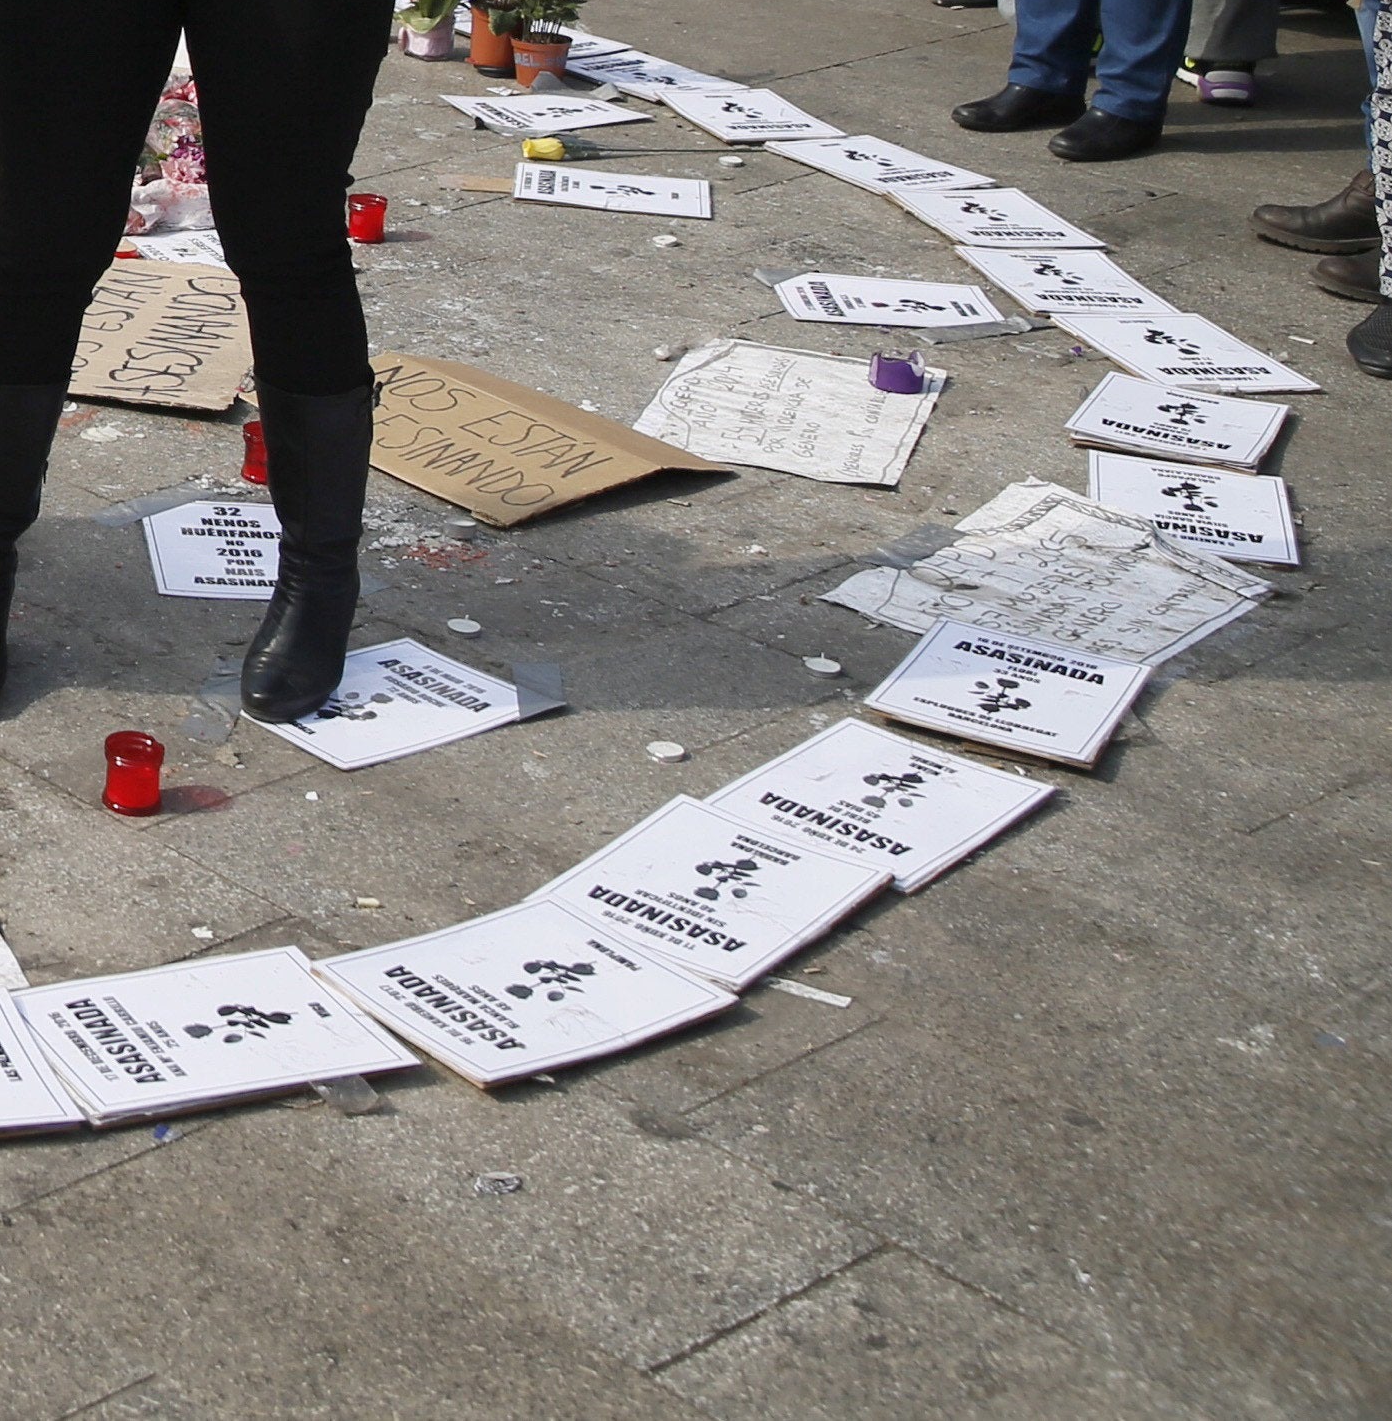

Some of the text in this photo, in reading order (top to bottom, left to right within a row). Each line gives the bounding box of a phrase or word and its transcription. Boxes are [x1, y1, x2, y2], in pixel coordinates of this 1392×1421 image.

[95, 275, 242, 397] ASESINANDO
[374, 365, 613, 479] NOS ESTÁN
[180, 525, 283, 540] HUÉRFANOS
[200, 517, 261, 529] NENOS
[212, 506, 242, 517] 32
[215, 548, 263, 558] 2016
[225, 539, 245, 547] NO
[225, 567, 266, 577] NAIS
[377, 658, 491, 714] ASASINADA
[953, 640, 1106, 686] ASASINADA
[759, 791, 915, 856] ASASINADA
[587, 885, 747, 954] ASASINADA
[384, 965, 527, 1050] ASASINADA
[65, 998, 167, 1084] ASASINADA
